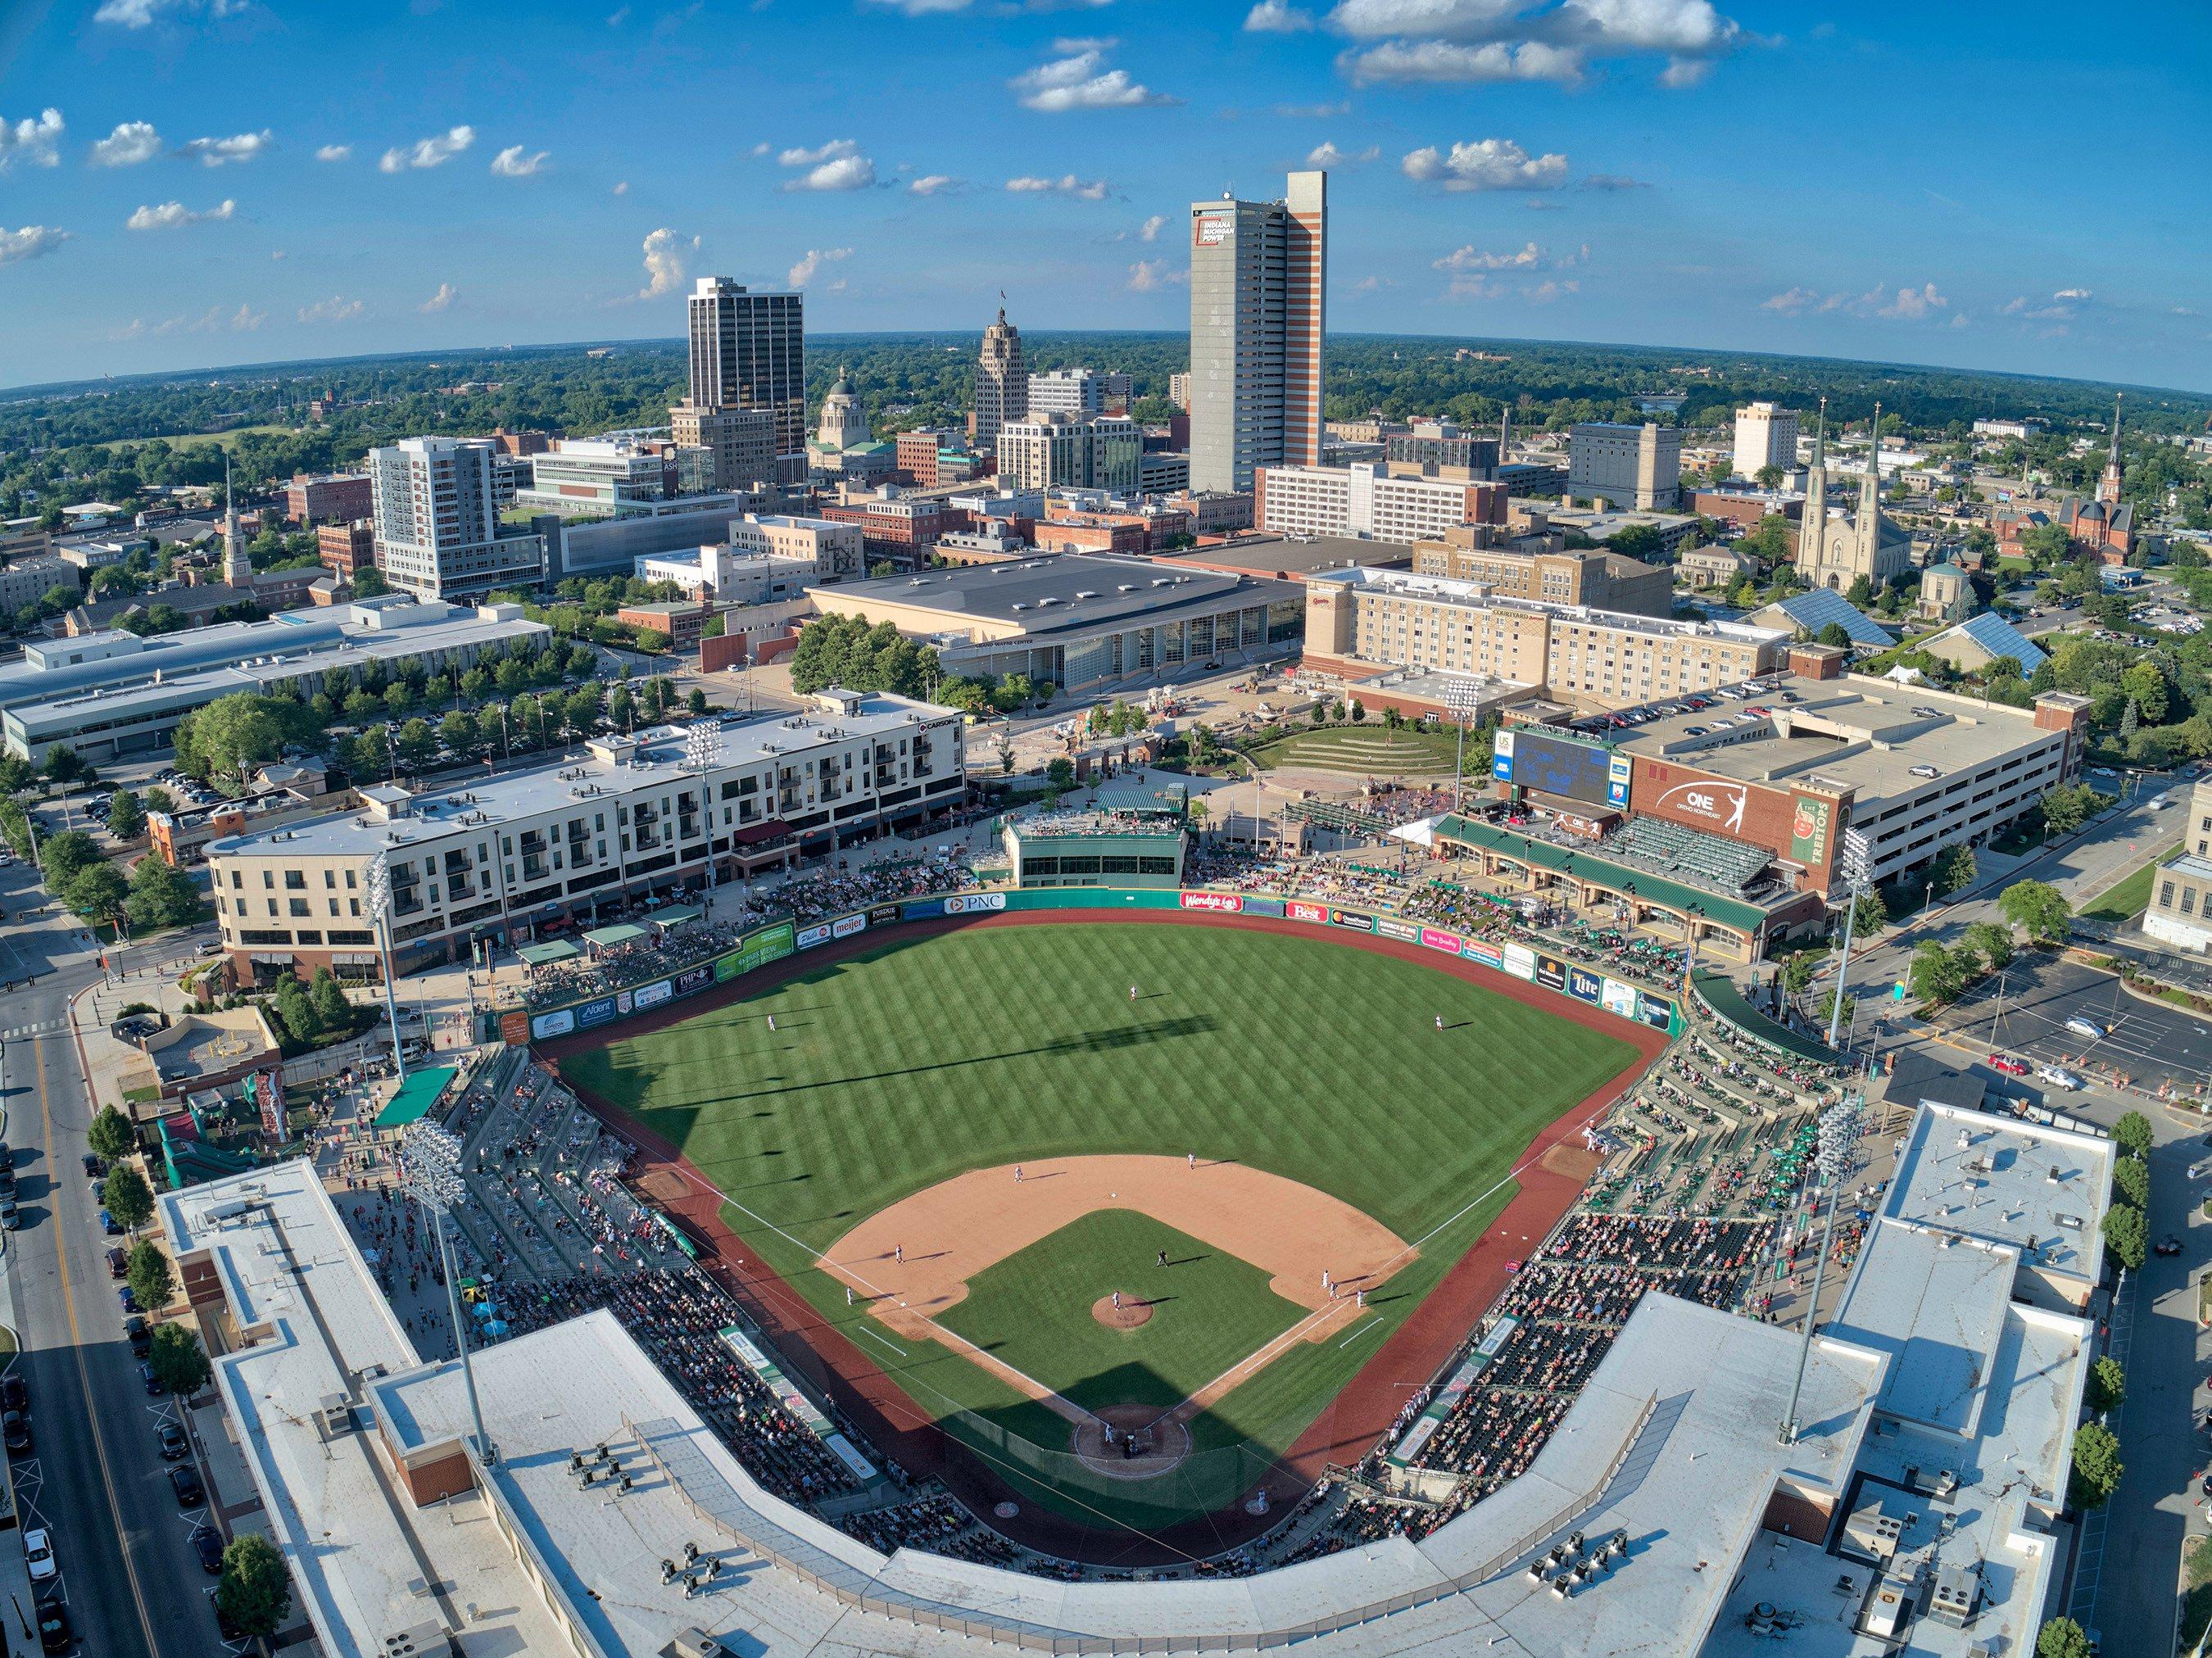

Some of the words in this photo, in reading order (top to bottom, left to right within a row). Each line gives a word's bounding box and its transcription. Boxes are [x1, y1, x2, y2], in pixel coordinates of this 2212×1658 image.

[1492, 609, 1529, 620] COURTYARD
[927, 718, 954, 729] CARSON
[1687, 792, 1715, 811] ONE
[1677, 804, 1693, 813] ORTHO
[1693, 808, 1721, 820] NORTHEAST
[1812, 802, 1829, 864] TREETOPS
[968, 895, 1000, 908] PNC
[1185, 894, 1221, 908] Wendy's
[873, 907, 896, 917] PURDUE
[1294, 904, 1320, 920] Best
[836, 917, 863, 933] meijer
[1379, 920, 1400, 930] SOURCE
[1438, 936, 1457, 949] Bradley
[680, 972, 696, 985] PHP
[1575, 975, 1598, 995] Lite
[582, 1001, 611, 1017] Afdent
[1711, 1008, 1736, 1031] UNIVERSITY
[1736, 1026, 1754, 1041] PICNIC
[1755, 1037, 1783, 1055] PAVILION
